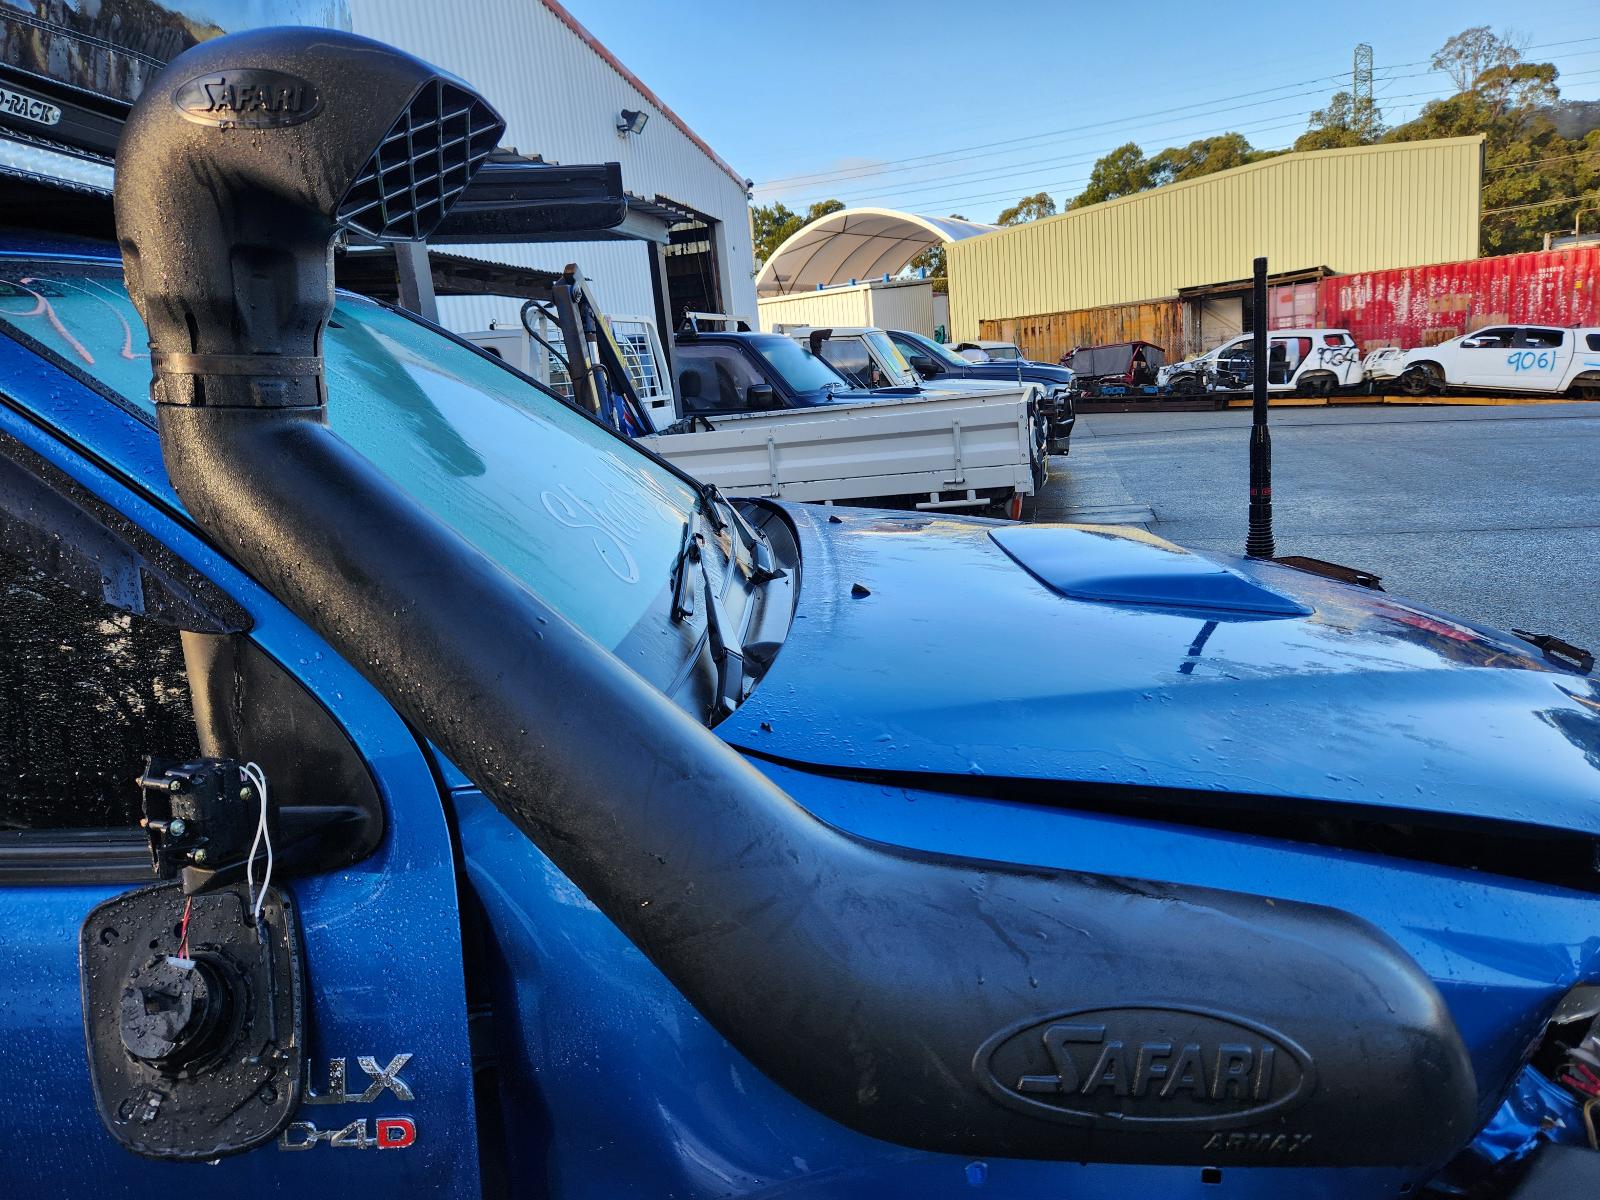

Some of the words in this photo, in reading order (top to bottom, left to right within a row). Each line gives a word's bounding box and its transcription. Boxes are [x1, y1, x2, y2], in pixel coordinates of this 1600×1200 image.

[188, 77, 305, 112] SAFARI
[1507, 351, 1556, 372] 9061
[1017, 1023, 1275, 1100] SAFARI
[278, 1117, 417, 1151] D-4D
[1203, 1133, 1313, 1152] ARMAX
